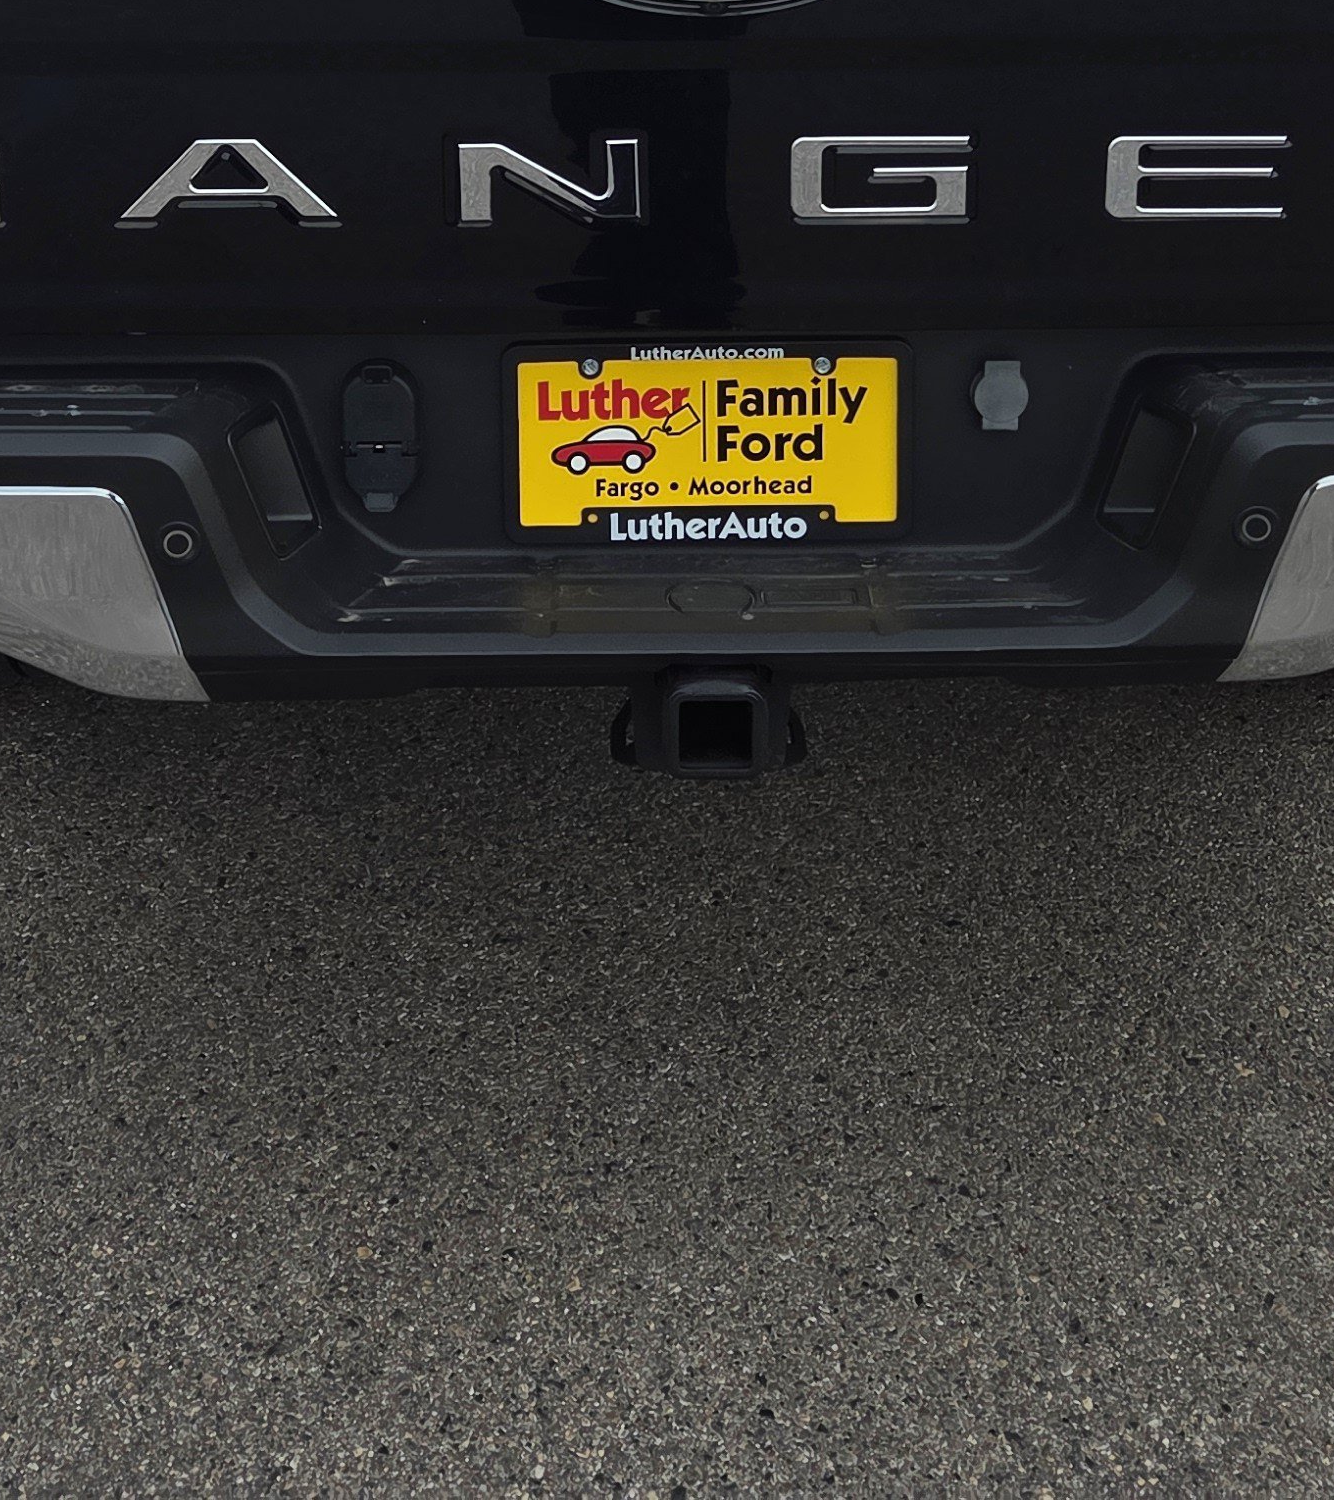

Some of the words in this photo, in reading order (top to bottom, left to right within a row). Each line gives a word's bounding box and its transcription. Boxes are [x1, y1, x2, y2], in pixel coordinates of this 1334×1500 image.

[630, 346, 785, 361] LutherAuto.com
[537, 378, 691, 421] Luther
[716, 376, 869, 425] Family
[716, 423, 824, 463] Ford
[595, 478, 660, 501] Fargo
[688, 475, 813, 496] Moorhead
[609, 511, 808, 541] LutherAuto
